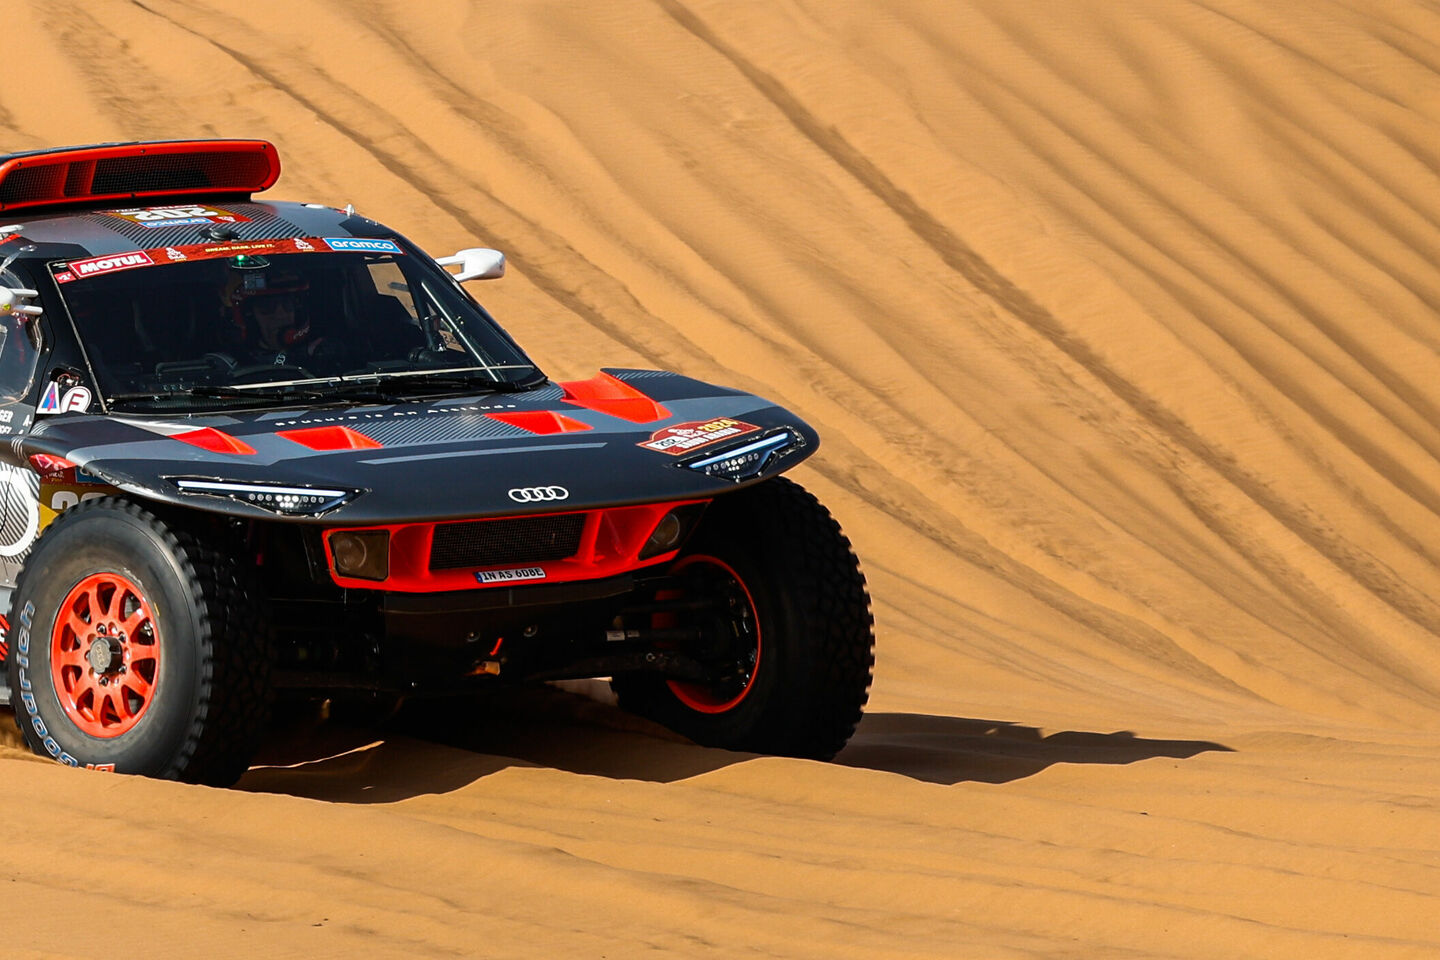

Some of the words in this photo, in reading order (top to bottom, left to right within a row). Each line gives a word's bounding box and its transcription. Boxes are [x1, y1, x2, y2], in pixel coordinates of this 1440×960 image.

[120, 206, 219, 221] 202
[331, 239, 394, 250] aramco
[79, 254, 148, 274] MOTUL
[698, 418, 740, 432] 2024
[499, 570, 513, 580] AS
